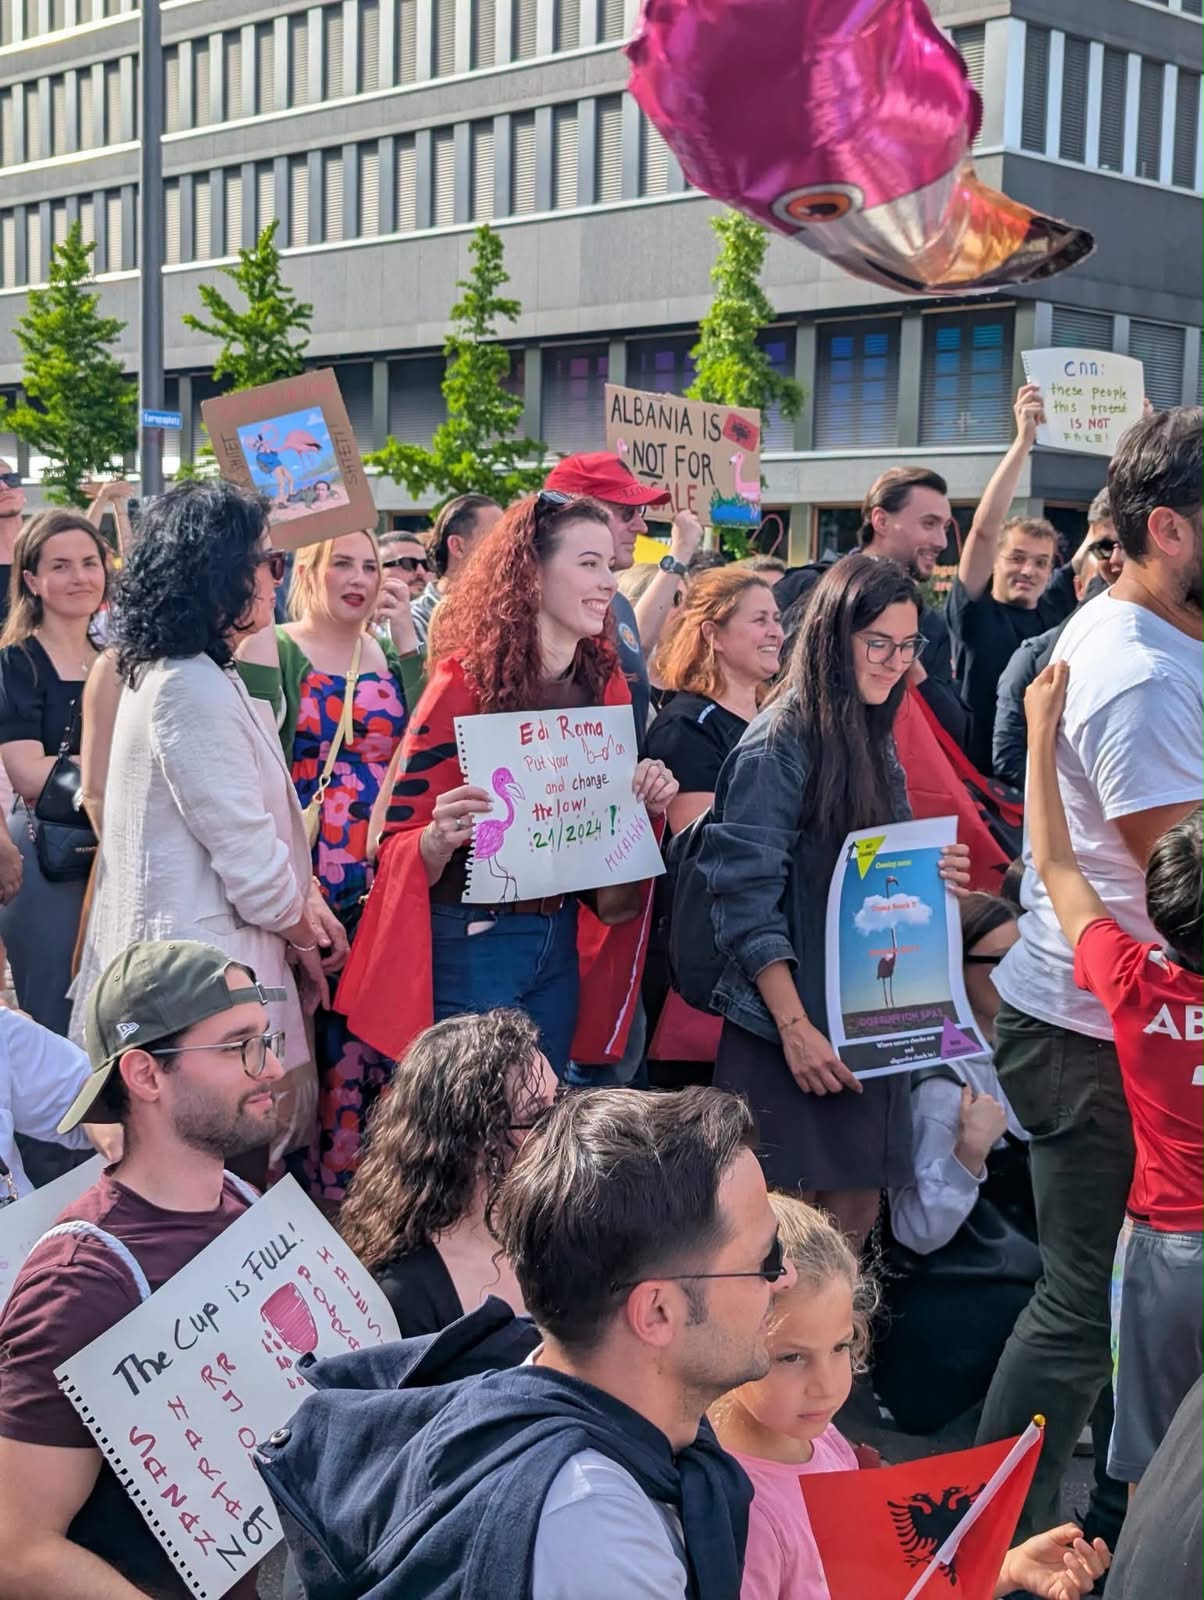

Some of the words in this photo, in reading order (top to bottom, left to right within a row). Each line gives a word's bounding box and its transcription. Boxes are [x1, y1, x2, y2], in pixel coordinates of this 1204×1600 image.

[1092, 387, 1127, 400] people
[611, 393, 693, 436] ALBANIA
[702, 411, 722, 442] IS
[1070, 418, 1082, 430] IS
[1088, 417, 1111, 430] NOT
[632, 440, 667, 475] NOT
[675, 445, 715, 486] FOR
[519, 720, 549, 745] Edi
[557, 715, 604, 739] Rama
[523, 754, 546, 772] Put
[550, 754, 569, 772] your
[545, 776, 565, 795] and
[572, 771, 610, 792] change
[112, 1351, 174, 1396] The
[173, 1301, 222, 1351] Cup
[225, 1280, 250, 1303] is
[240, 1220, 306, 1281] FULL!
[129, 1425, 216, 1557] SAZAN
[216, 1505, 274, 1572] NOT
